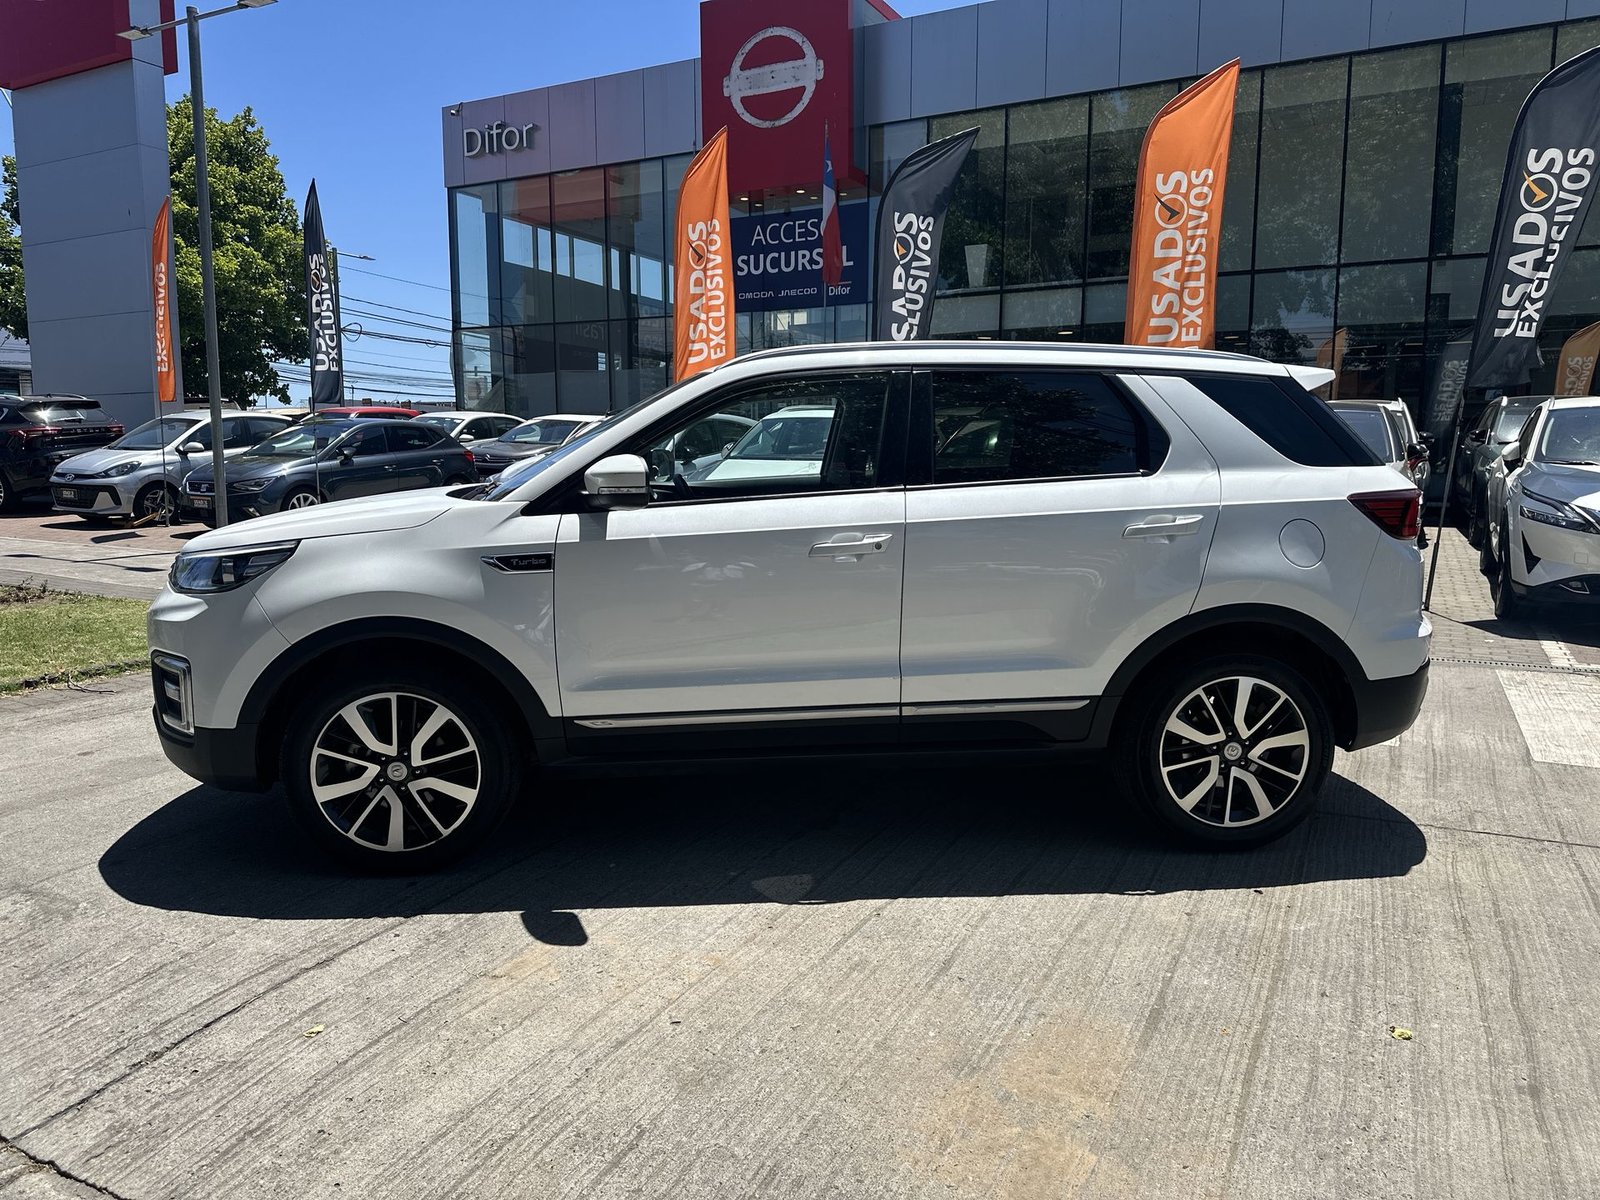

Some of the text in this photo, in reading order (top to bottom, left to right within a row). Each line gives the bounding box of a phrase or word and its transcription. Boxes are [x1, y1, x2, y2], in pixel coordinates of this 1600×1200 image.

[463, 120, 534, 157] Difor
[688, 221, 709, 365] USADOS
[706, 218, 727, 360] EXCLUSIVOS
[736, 245, 854, 276] SUCURSL
[738, 290, 775, 300] OMODA
[751, 218, 823, 247] ACCES
[828, 285, 851, 296] Difor
[891, 211, 918, 341] SADOS
[905, 215, 935, 341] LUSIVOS
[1147, 170, 1188, 343] USADOS
[1180, 168, 1214, 342] EXCLUSIVOS
[1493, 147, 1563, 337] USADOS
[1515, 147, 1595, 338] EXCLUSIVOS
[510, 557, 547, 566] Turbo
